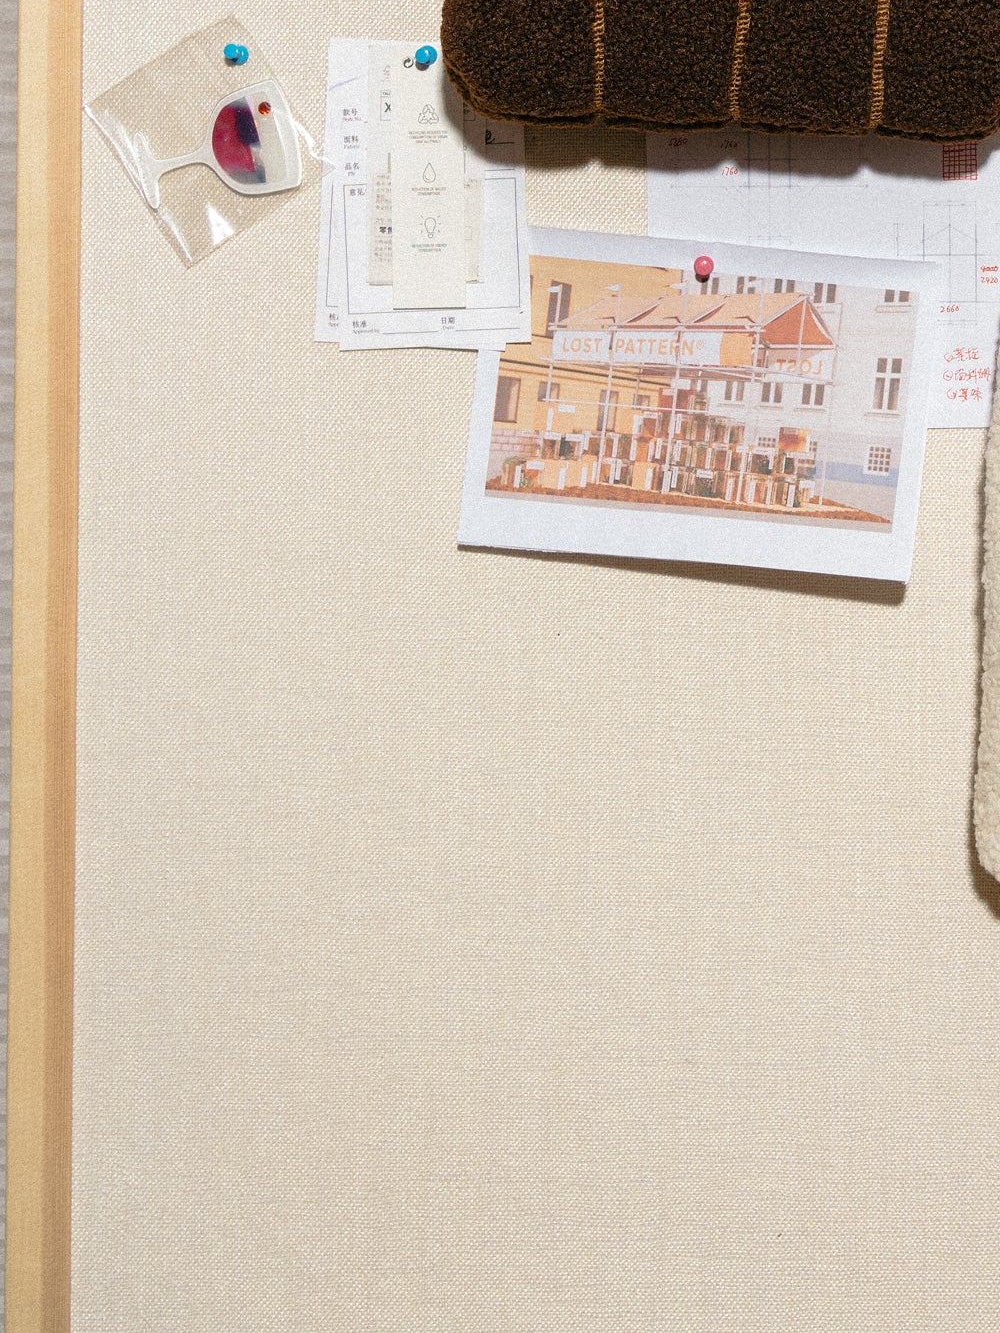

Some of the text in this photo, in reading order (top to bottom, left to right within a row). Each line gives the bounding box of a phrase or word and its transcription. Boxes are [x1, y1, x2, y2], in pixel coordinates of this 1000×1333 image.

[721, 166, 739, 177] 1760
[940, 305, 960, 314] 2660
[441, 316, 455, 325] 日期
[561, 337, 603, 354] LOST
